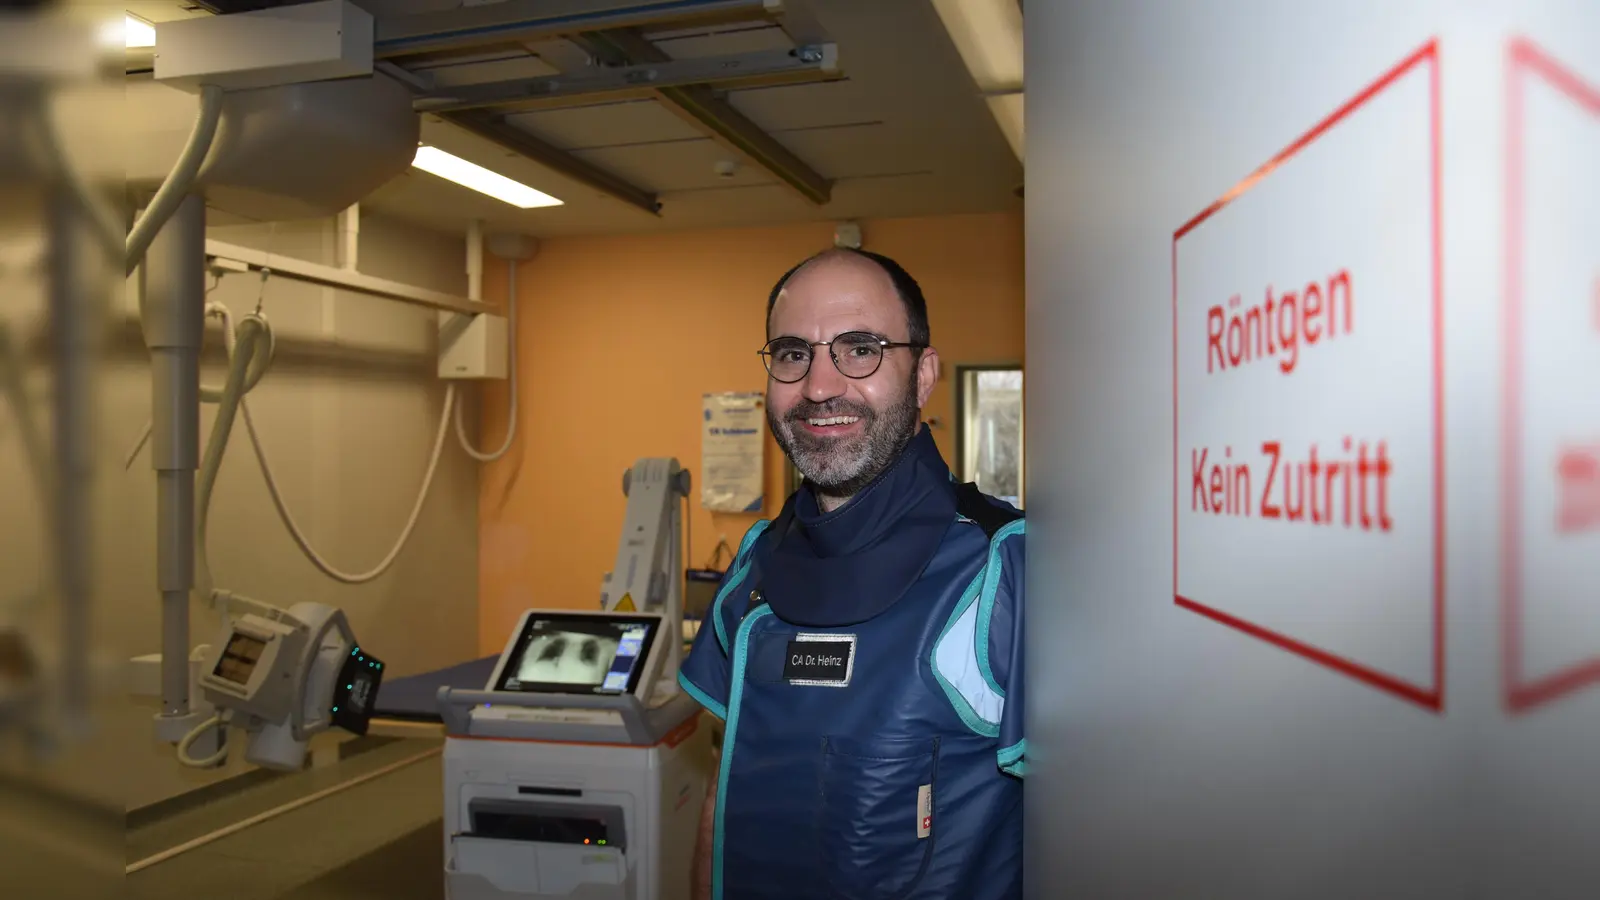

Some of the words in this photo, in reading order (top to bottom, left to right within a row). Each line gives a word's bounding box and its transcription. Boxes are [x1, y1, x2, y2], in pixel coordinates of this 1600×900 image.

[1207, 268, 1353, 374] Röntgen
[1191, 446, 1251, 517] Kein
[1260, 436, 1393, 532] Zutritt
[791, 654, 804, 666] CA
[805, 654, 816, 666] Dr.
[817, 654, 842, 666] Heinz
